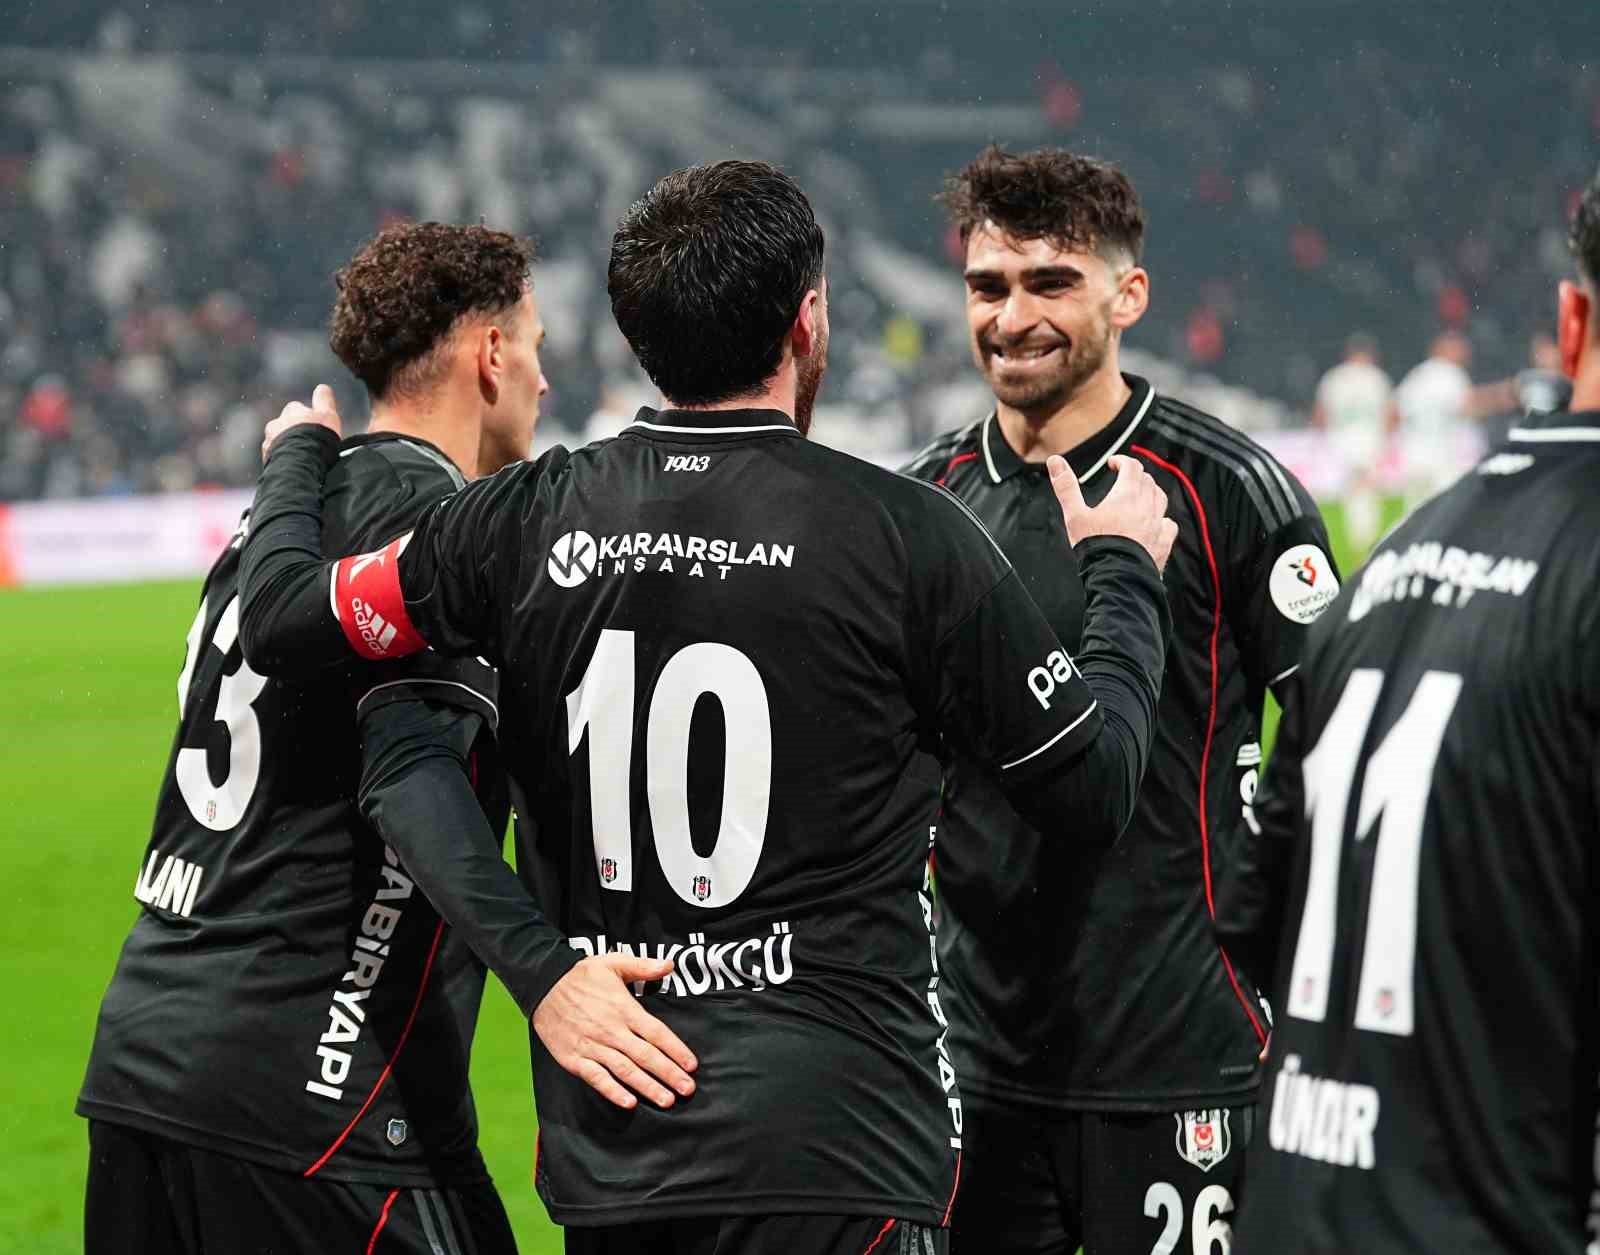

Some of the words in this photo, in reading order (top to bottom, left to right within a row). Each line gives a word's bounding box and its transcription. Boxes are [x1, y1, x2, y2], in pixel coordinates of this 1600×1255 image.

[664, 455, 711, 472] 1903
[599, 532, 796, 568] KARAARSLAN
[176, 595, 270, 832] 3
[565, 628, 773, 909] 10
[134, 849, 204, 918] LANI
[1286, 667, 1465, 1037] 11
[657, 921, 793, 997] KÖKÇÜ
[1143, 1182, 1235, 1255] 26
